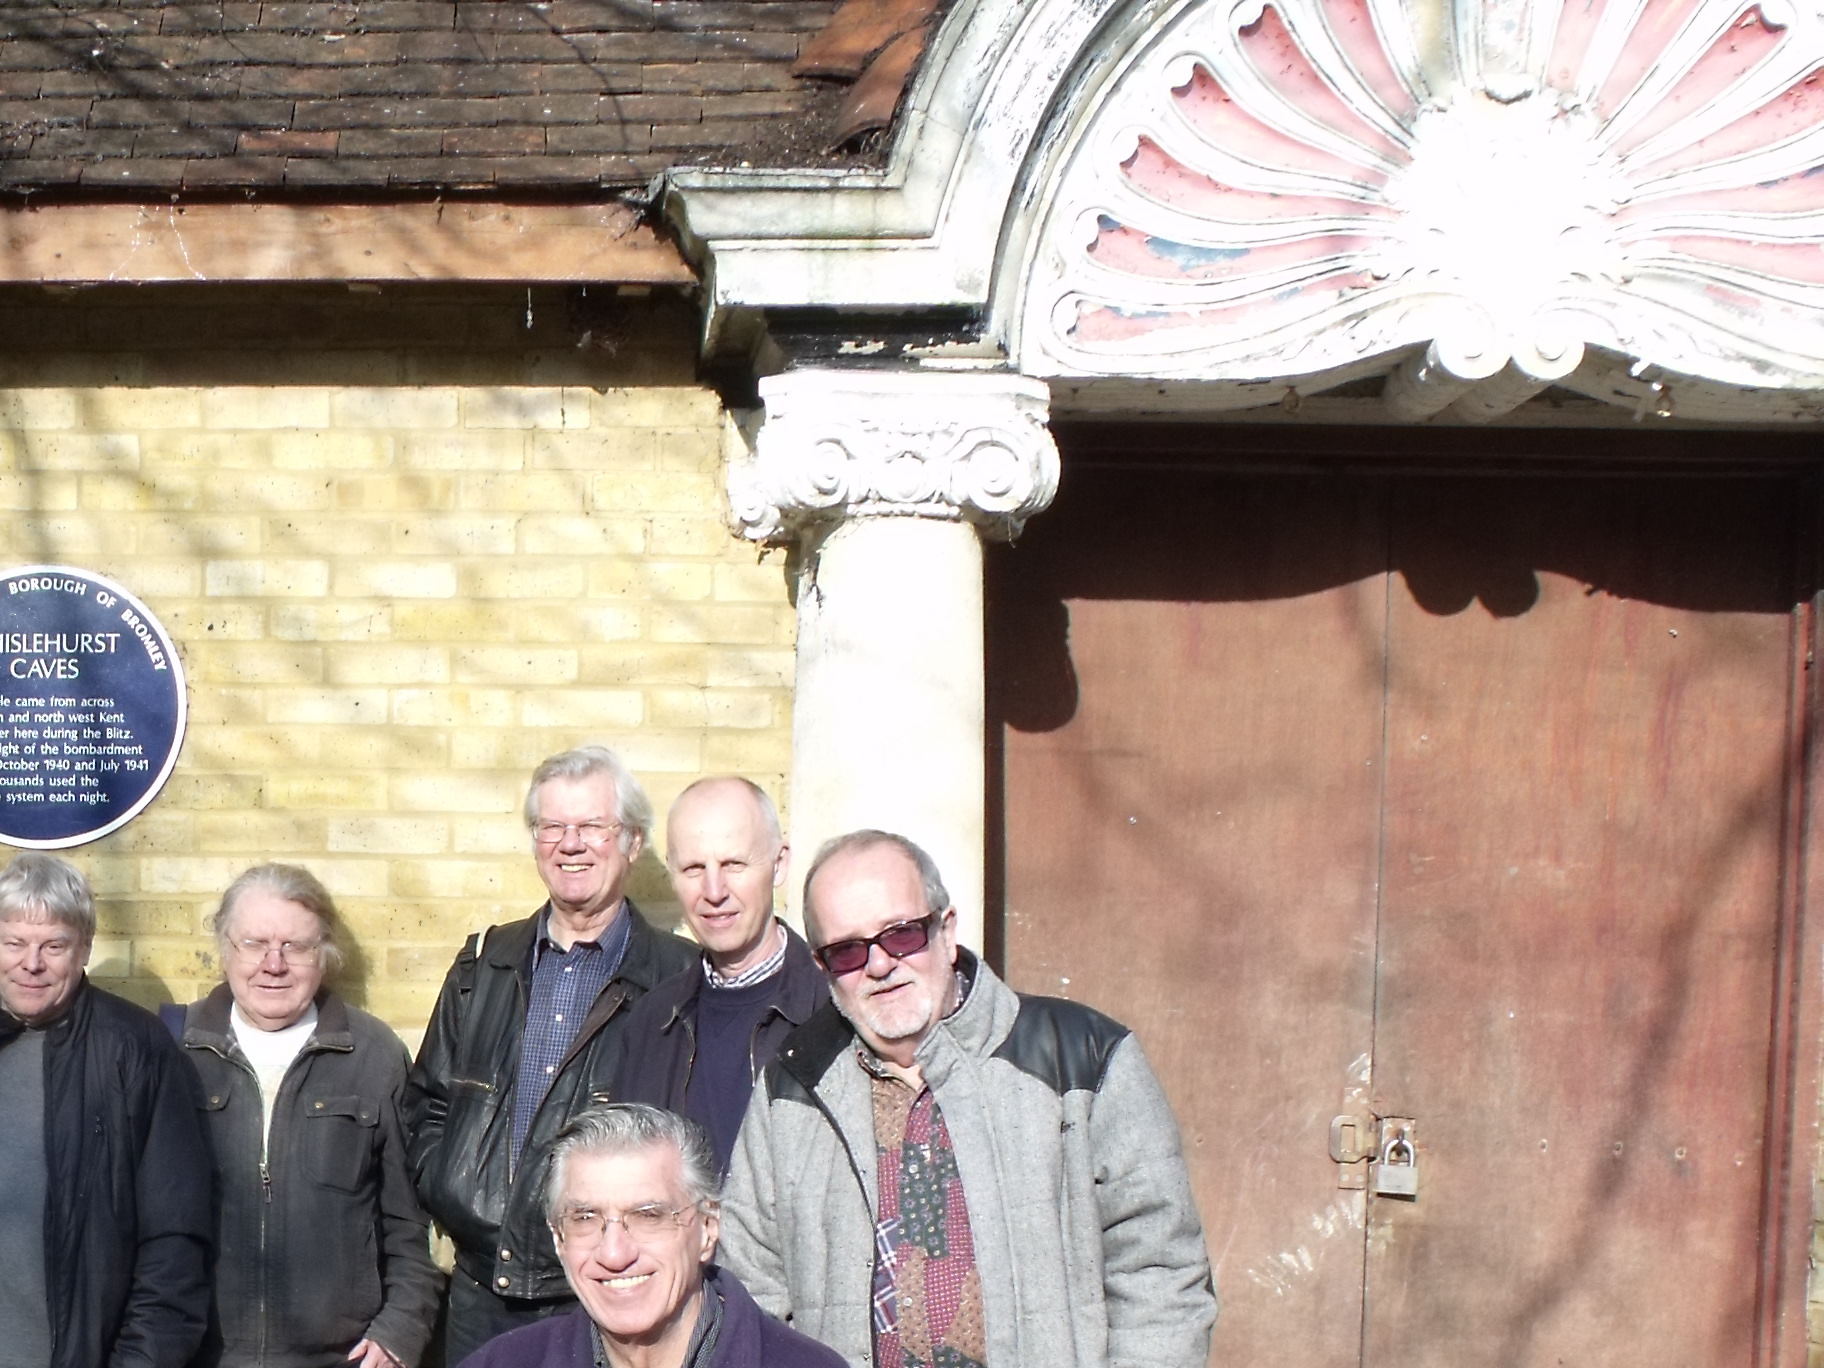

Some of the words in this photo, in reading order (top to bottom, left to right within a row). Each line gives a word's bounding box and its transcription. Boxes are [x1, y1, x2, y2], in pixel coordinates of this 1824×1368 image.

[8, 577, 87, 595] BOROUGH
[96, 591, 117, 609] OF
[120, 609, 168, 672] BROMLEY
[10, 658, 79, 679] CAVES
[16, 697, 45, 707] came
[50, 696, 75, 707] from
[81, 697, 114, 707] across
[9, 712, 29, 722] and
[34, 712, 64, 722] north
[69, 714, 94, 722] west
[100, 712, 124, 722] Kent
[14, 728, 38, 738] here
[43, 728, 77, 741] during
[83, 728, 101, 738] the
[106, 728, 133, 739] Blitz.
[24, 743, 36, 754] of
[41, 744, 58, 754] the
[64, 744, 142, 755] bombardment
[45, 760, 69, 770] 1940
[75, 760, 95, 770] and
[100, 760, 120, 772] July
[126, 760, 149, 770] 1941
[49, 776, 75, 786] used
[81, 776, 98, 786] the
[6, 792, 44, 804] system
[49, 792, 75, 802] each
[80, 792, 109, 805] night.
